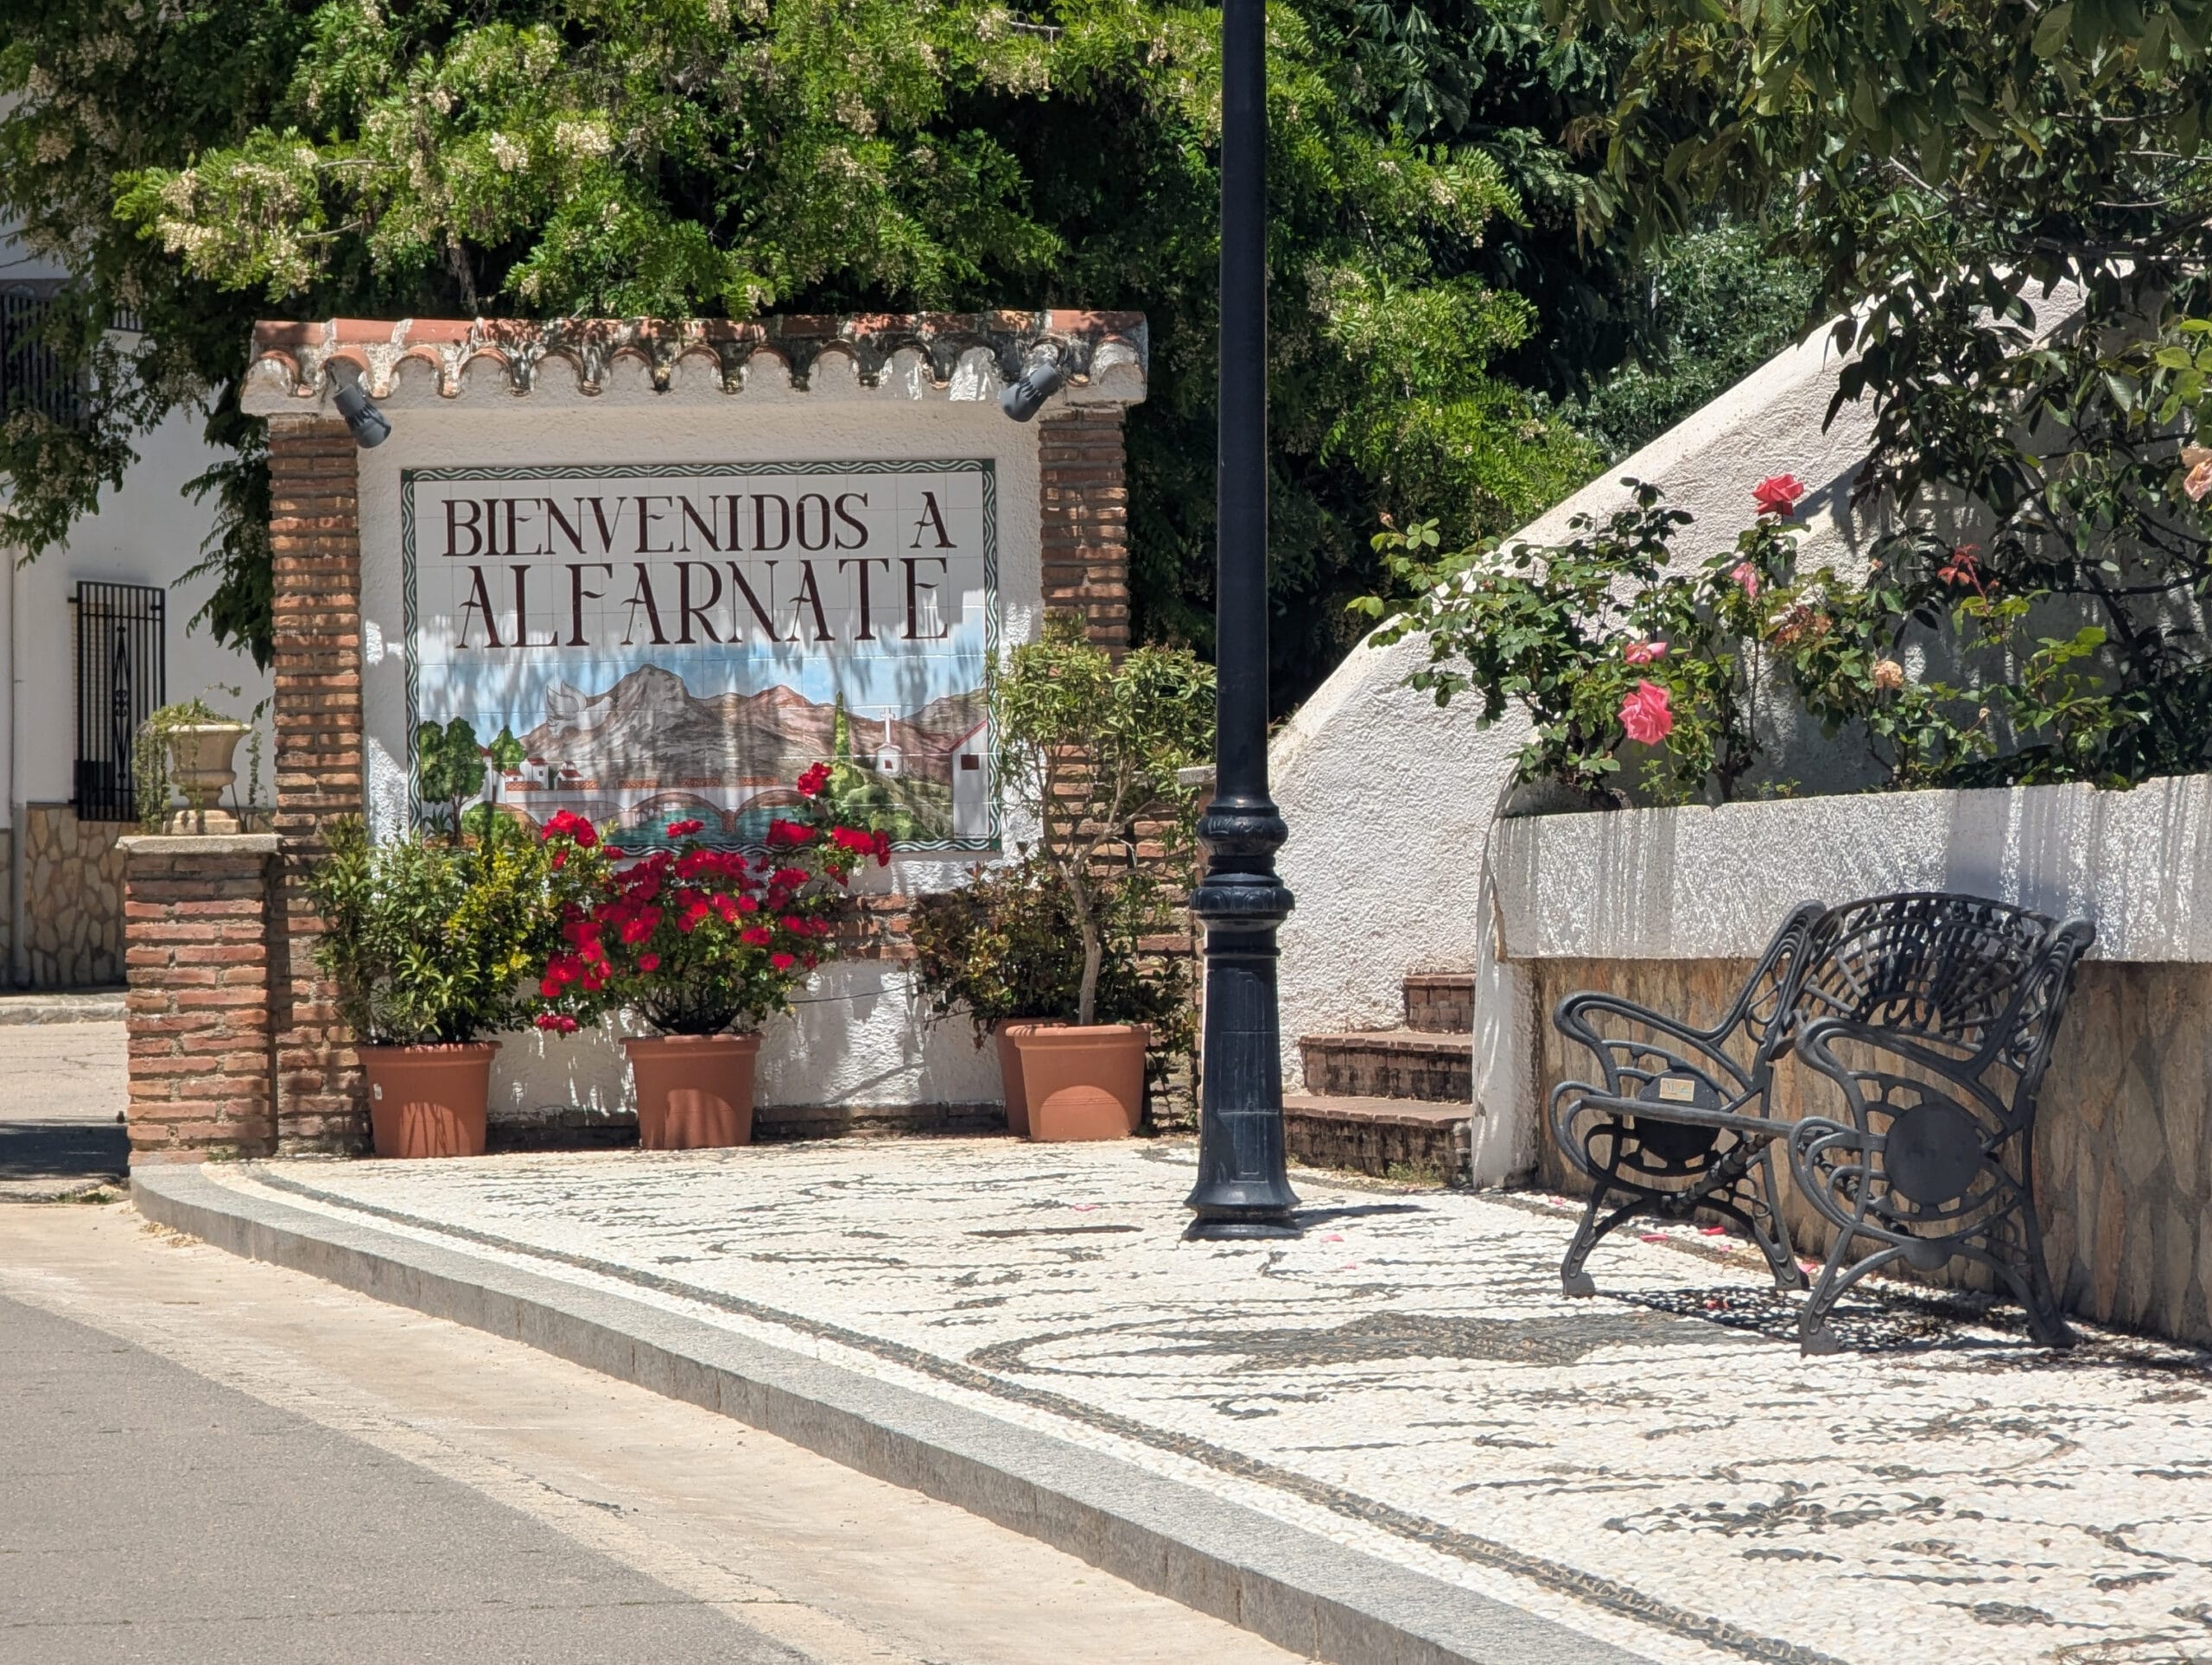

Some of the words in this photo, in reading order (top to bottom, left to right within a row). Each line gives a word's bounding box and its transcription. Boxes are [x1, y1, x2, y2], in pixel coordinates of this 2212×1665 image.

[442, 493, 868, 556] BIENVENIDOS
[910, 492, 957, 548] A
[454, 557, 948, 648] ALFARNATE
